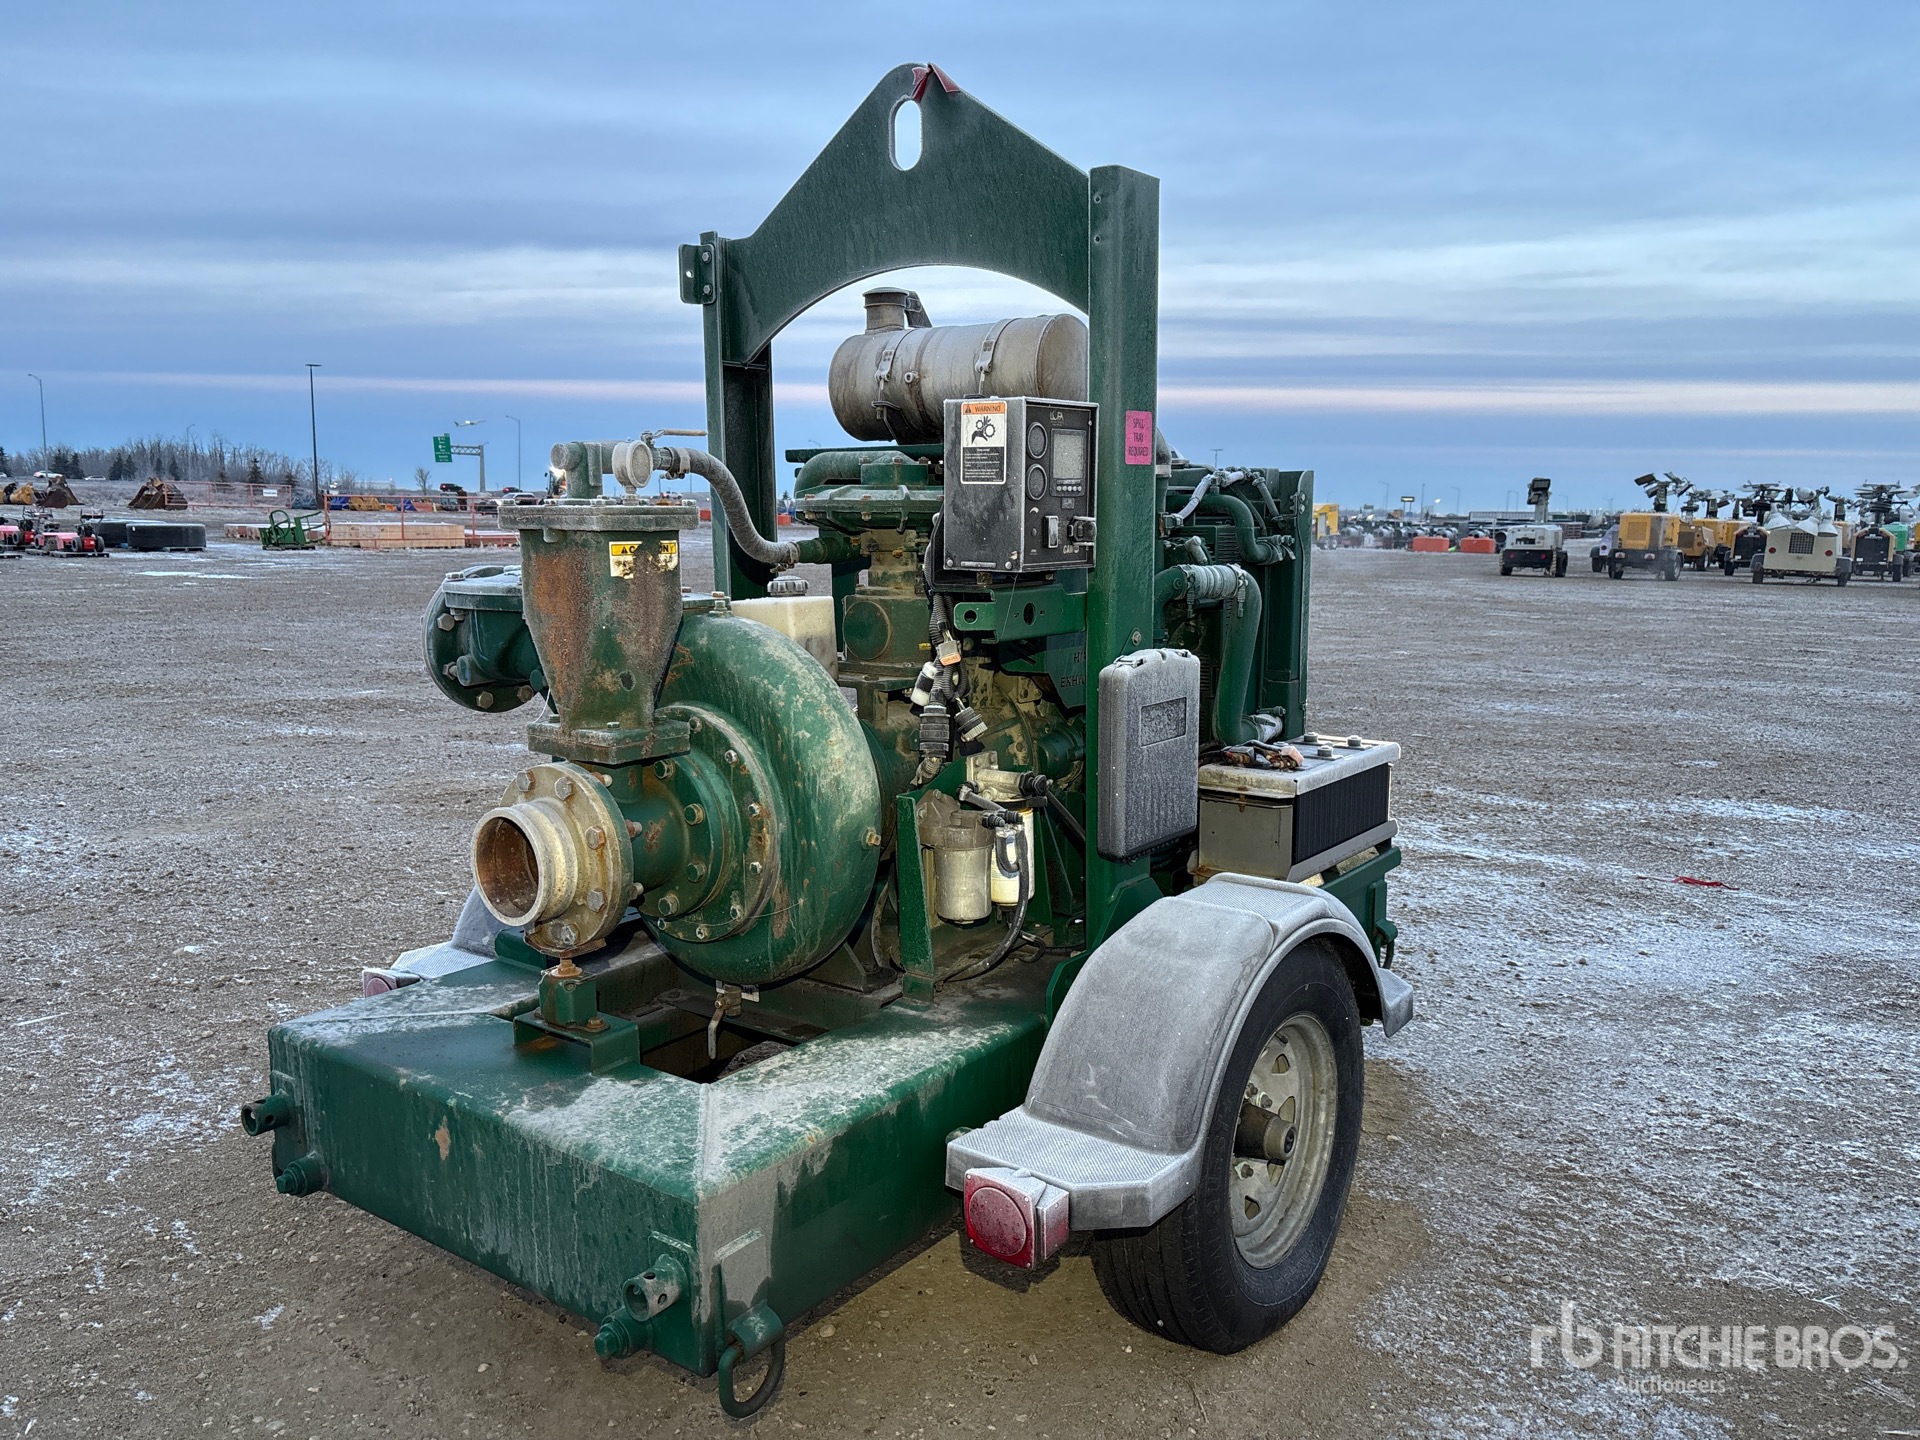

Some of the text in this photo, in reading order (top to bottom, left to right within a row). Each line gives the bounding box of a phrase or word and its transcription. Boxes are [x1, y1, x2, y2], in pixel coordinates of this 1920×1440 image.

[975, 405, 1001, 413] WARNING
[1133, 418, 1145, 429] SPILL
[1133, 432, 1144, 443] TRAY
[1128, 446, 1149, 457] REQUIRED
